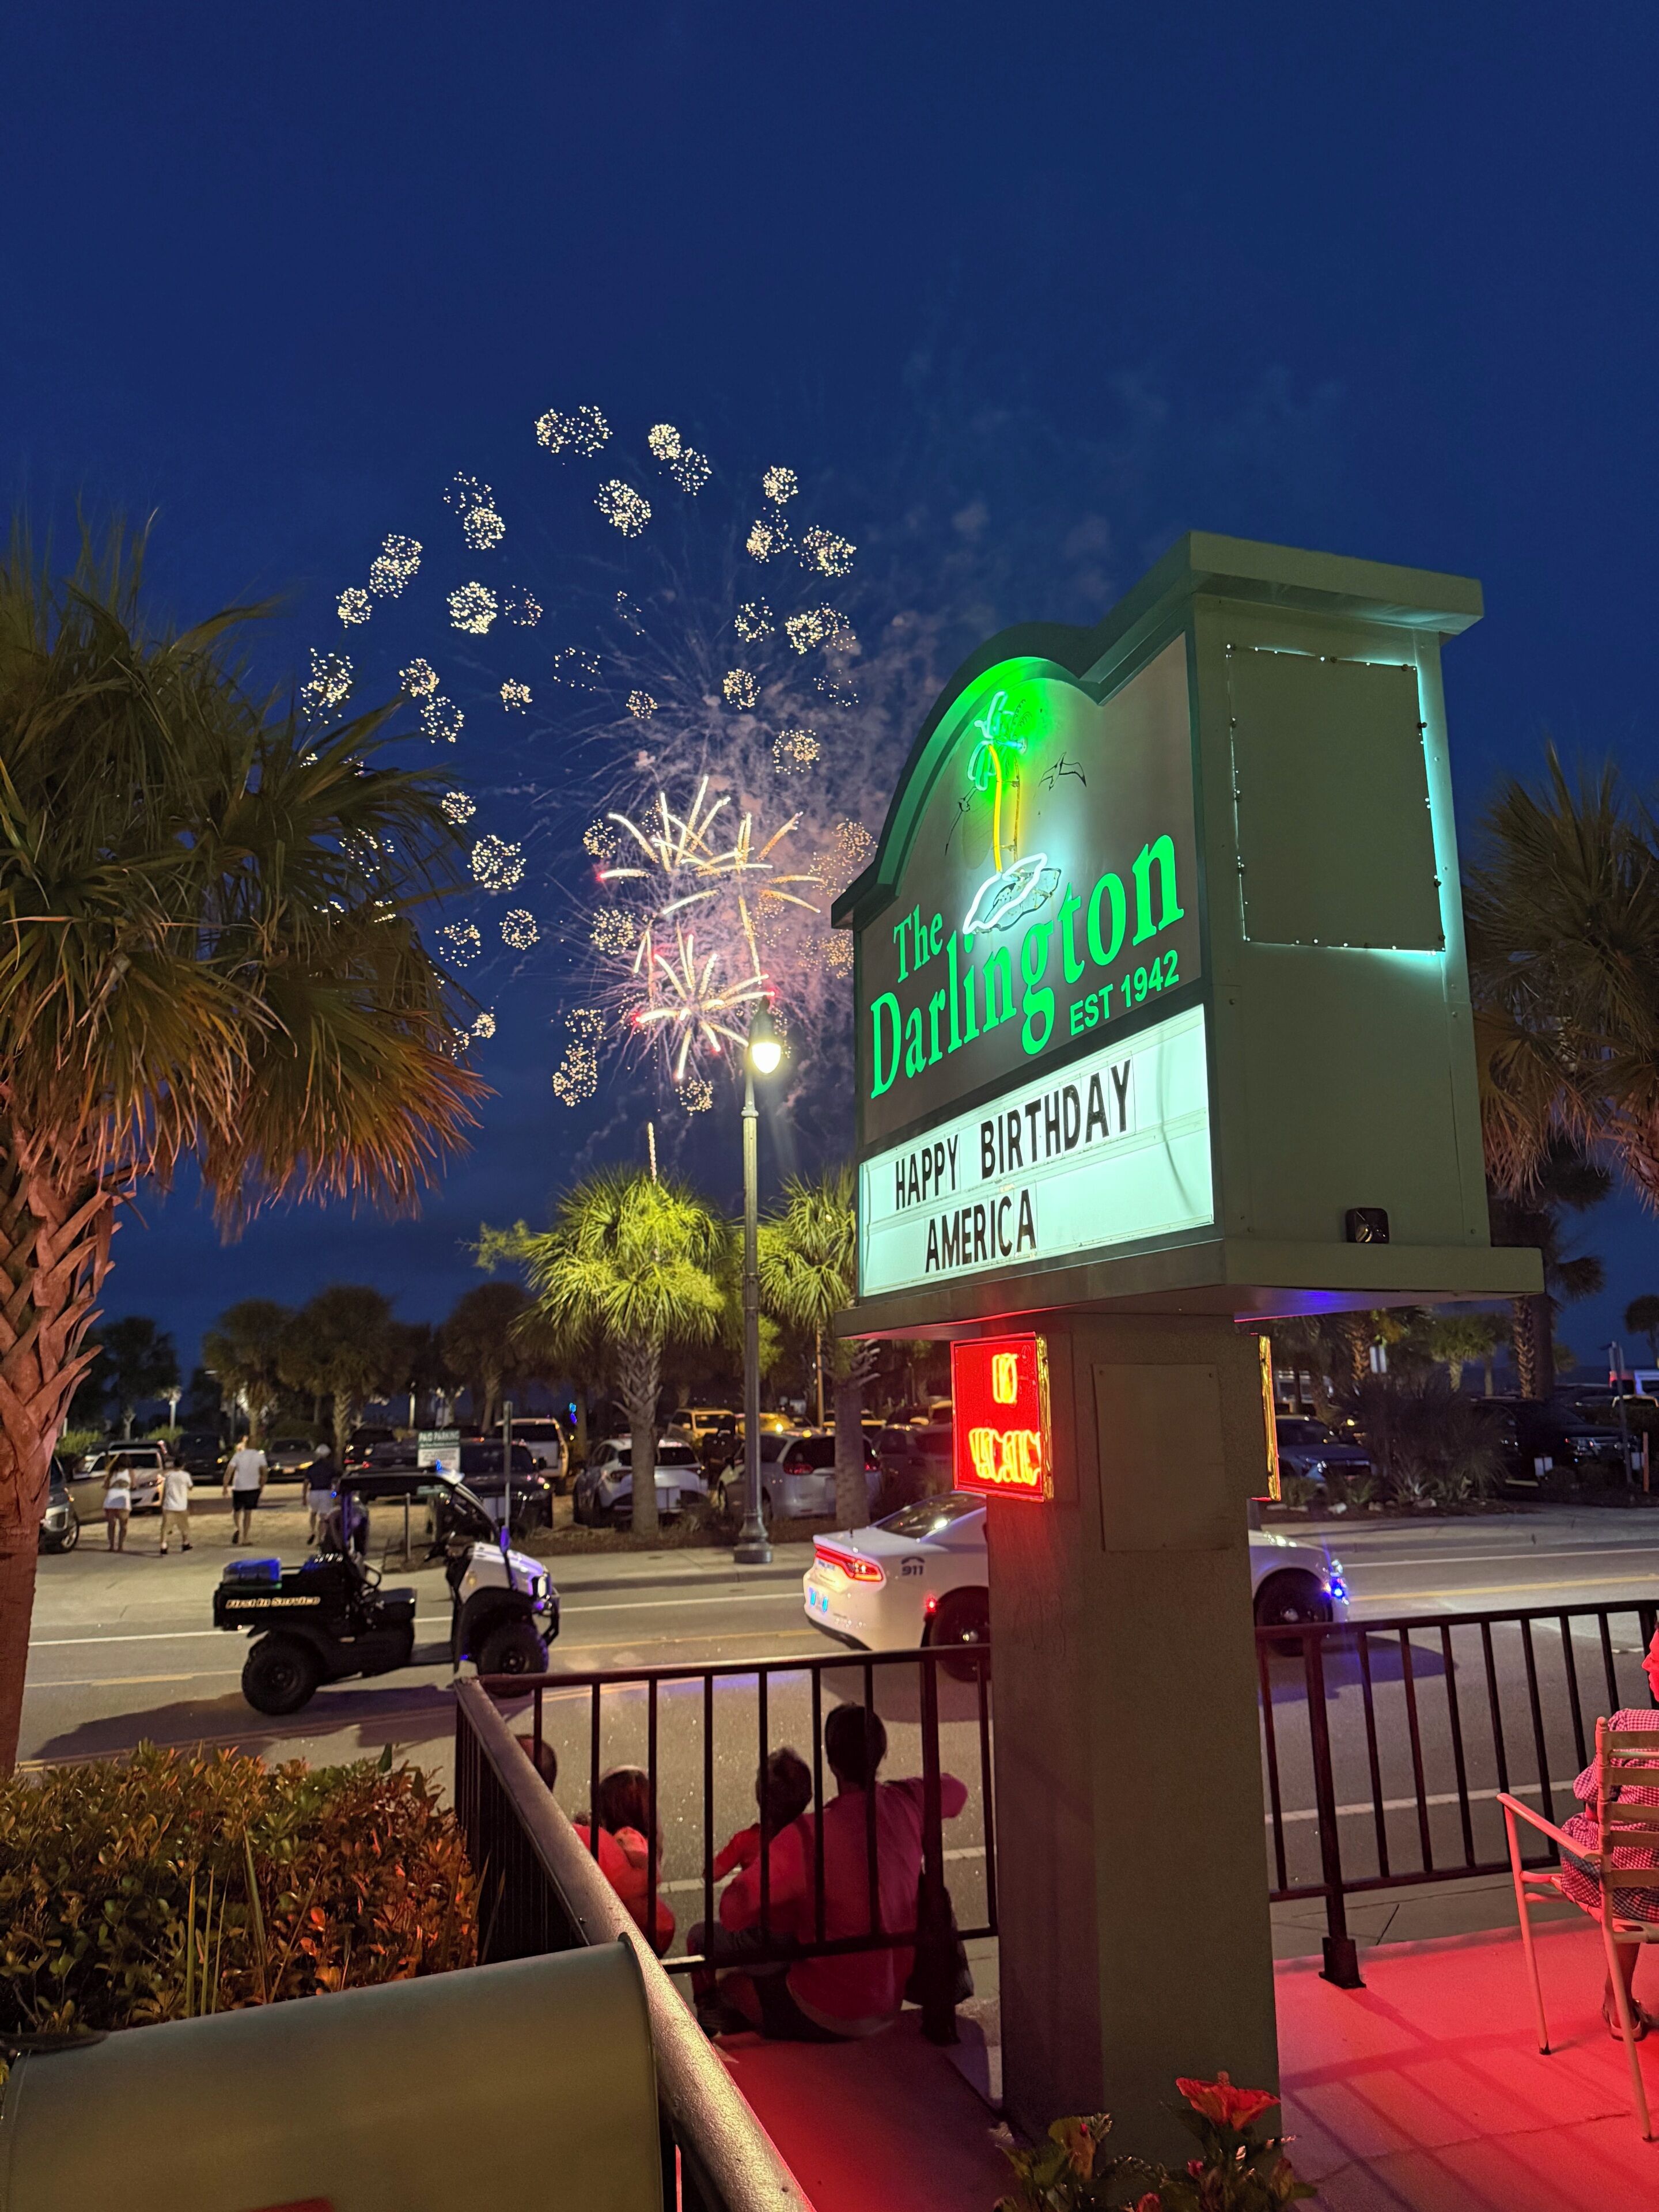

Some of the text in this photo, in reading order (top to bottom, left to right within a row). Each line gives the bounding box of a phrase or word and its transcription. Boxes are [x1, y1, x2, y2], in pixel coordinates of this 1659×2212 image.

[870, 835, 1184, 1099] Darlington
[893, 904, 943, 983] The
[1070, 949, 1180, 1036] EST 1942
[896, 1059, 1131, 1211] HAPPY BIRTHDAY
[925, 1188, 1037, 1273] AMERICA
[902, 1566, 924, 1576] 911
